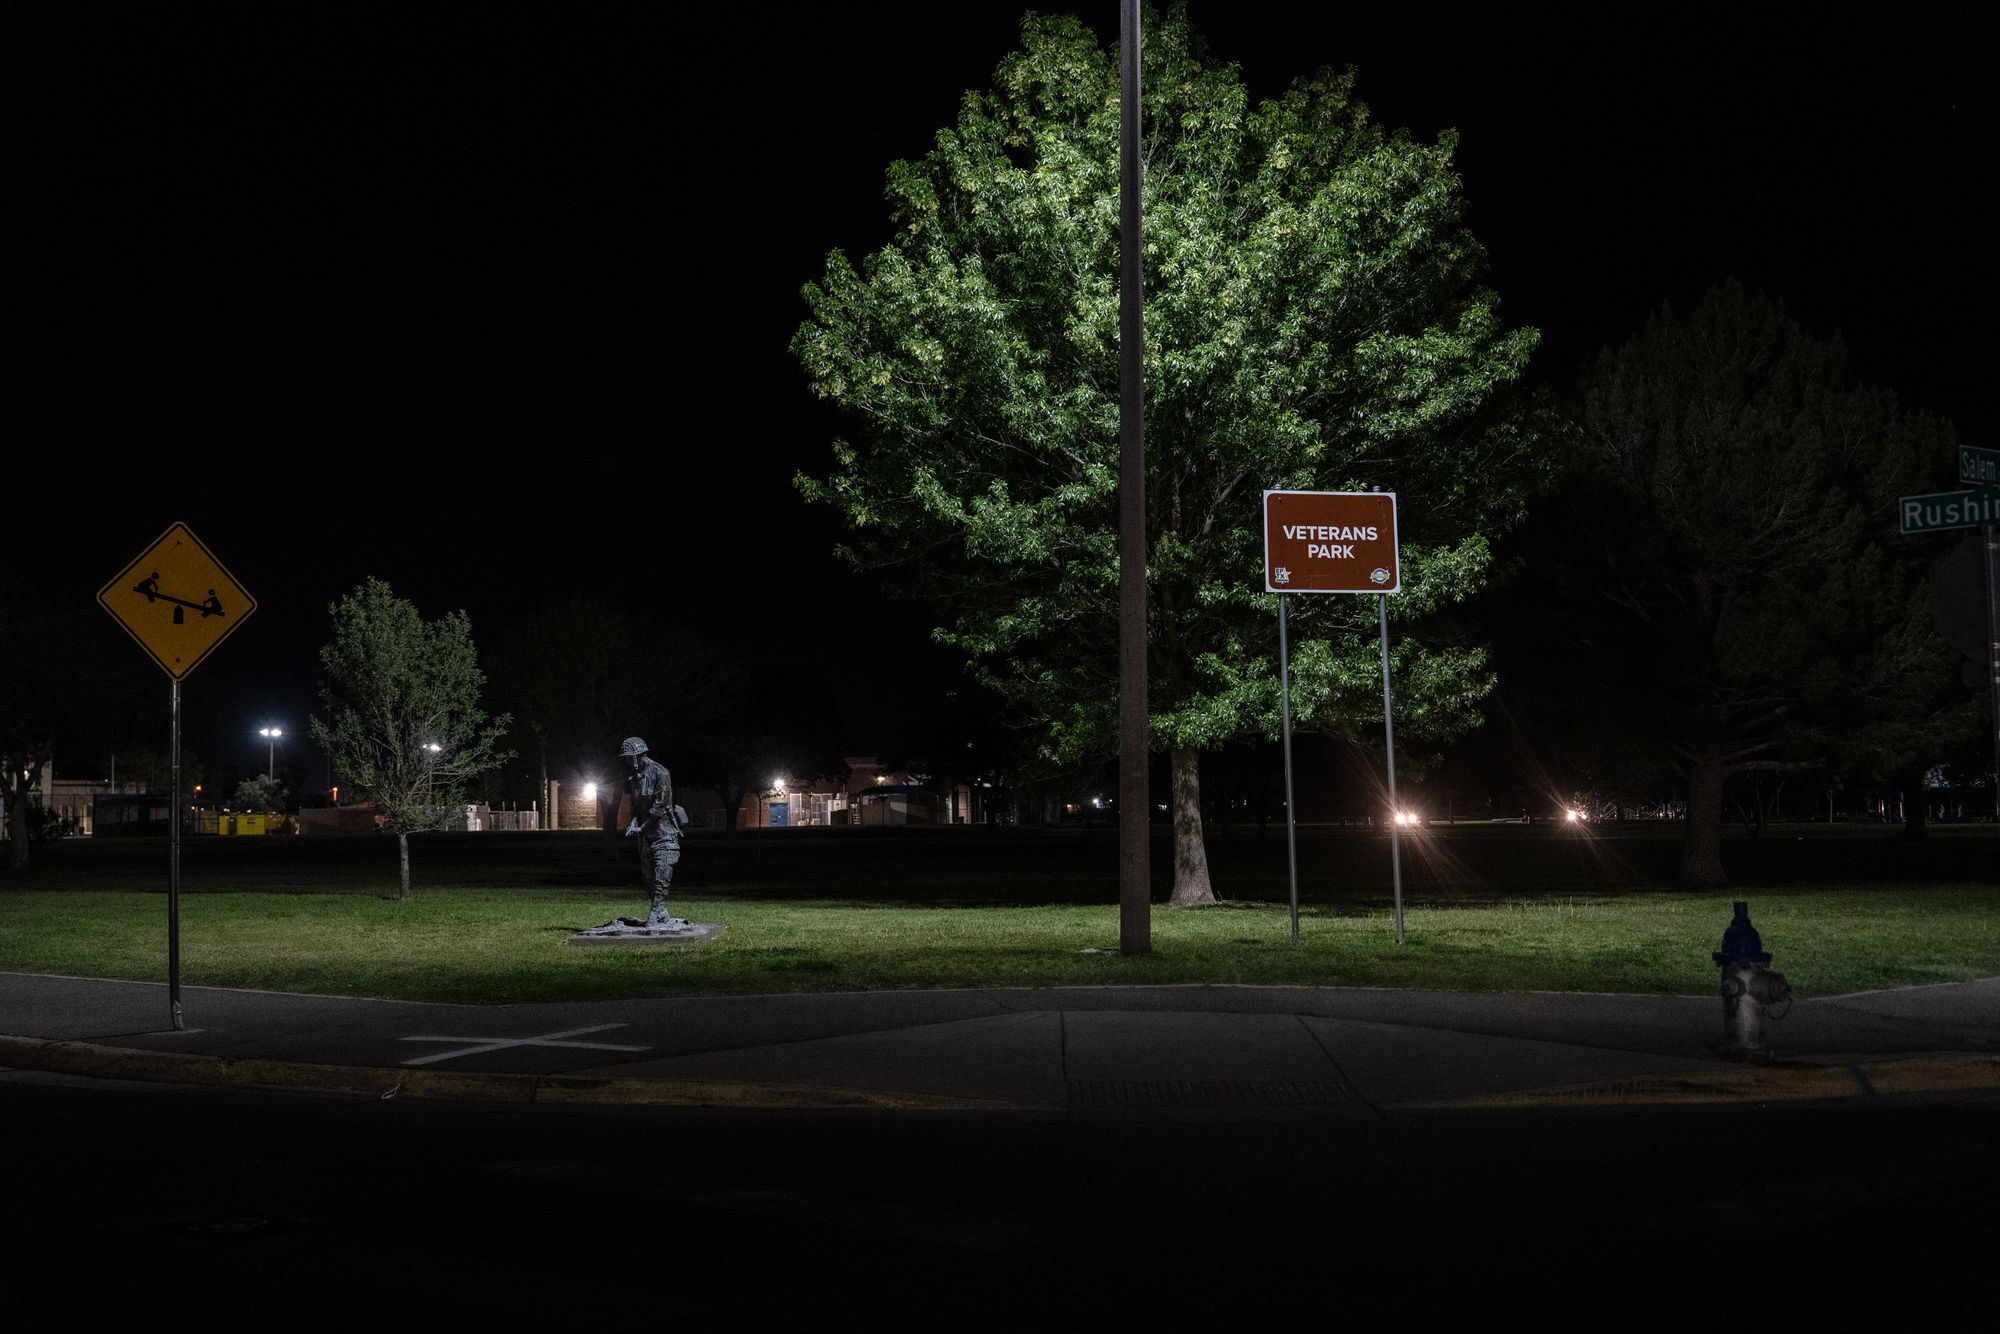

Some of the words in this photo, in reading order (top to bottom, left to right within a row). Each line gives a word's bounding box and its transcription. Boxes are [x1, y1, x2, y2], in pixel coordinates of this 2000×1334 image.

[1962, 451, 1996, 480] Salem
[1283, 525, 1379, 541] VETERANS
[1308, 544, 1355, 559] PARK
